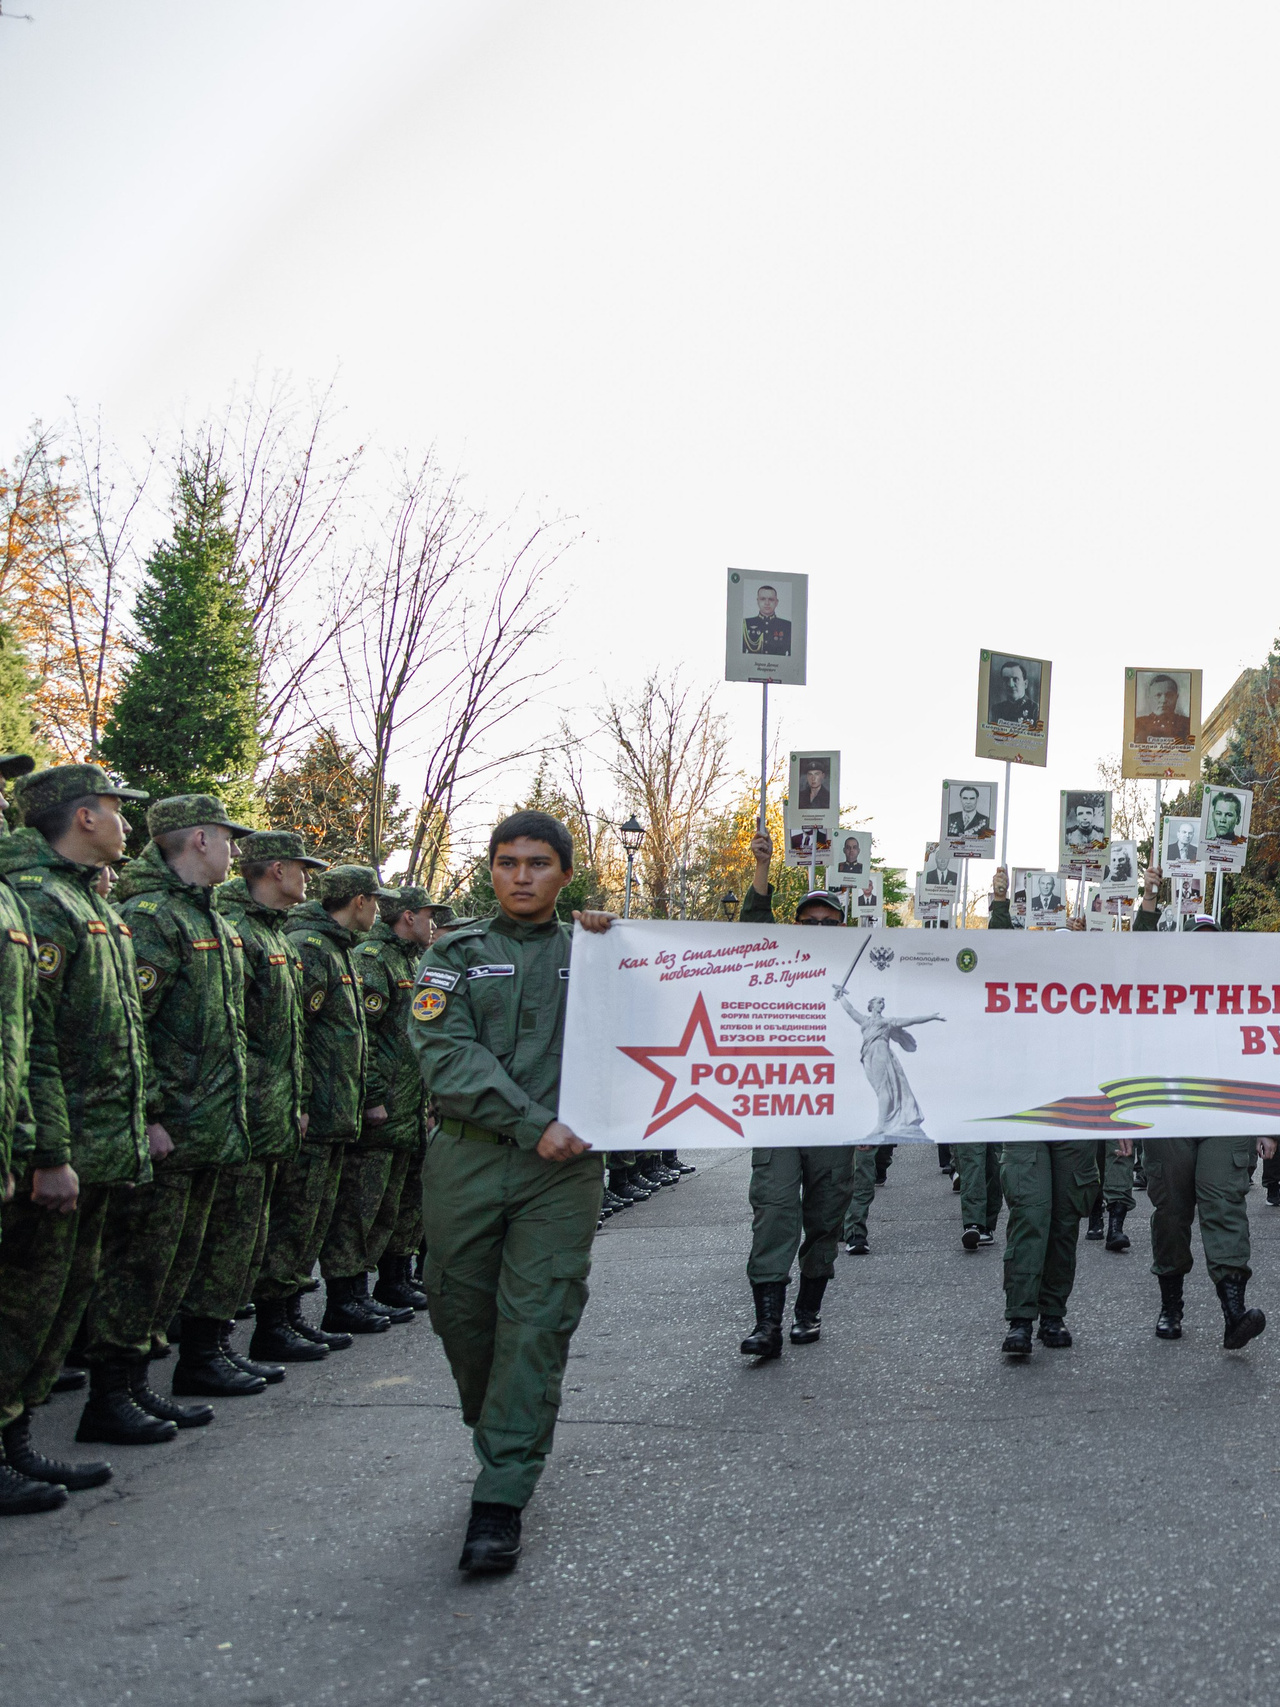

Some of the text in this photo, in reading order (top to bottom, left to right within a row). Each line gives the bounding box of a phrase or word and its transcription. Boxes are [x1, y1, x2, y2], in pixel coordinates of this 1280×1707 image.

[618, 938, 779, 970] Как без Сталинграда
[721, 1001, 826, 1011] ВСЕРОССИЙСКИЙ
[720, 1034, 826, 1042] ВУЗОВ РОССИИ
[691, 1062, 835, 1089] РОДНАЯ
[732, 1093, 835, 1117] ЗЕМЛЯ
